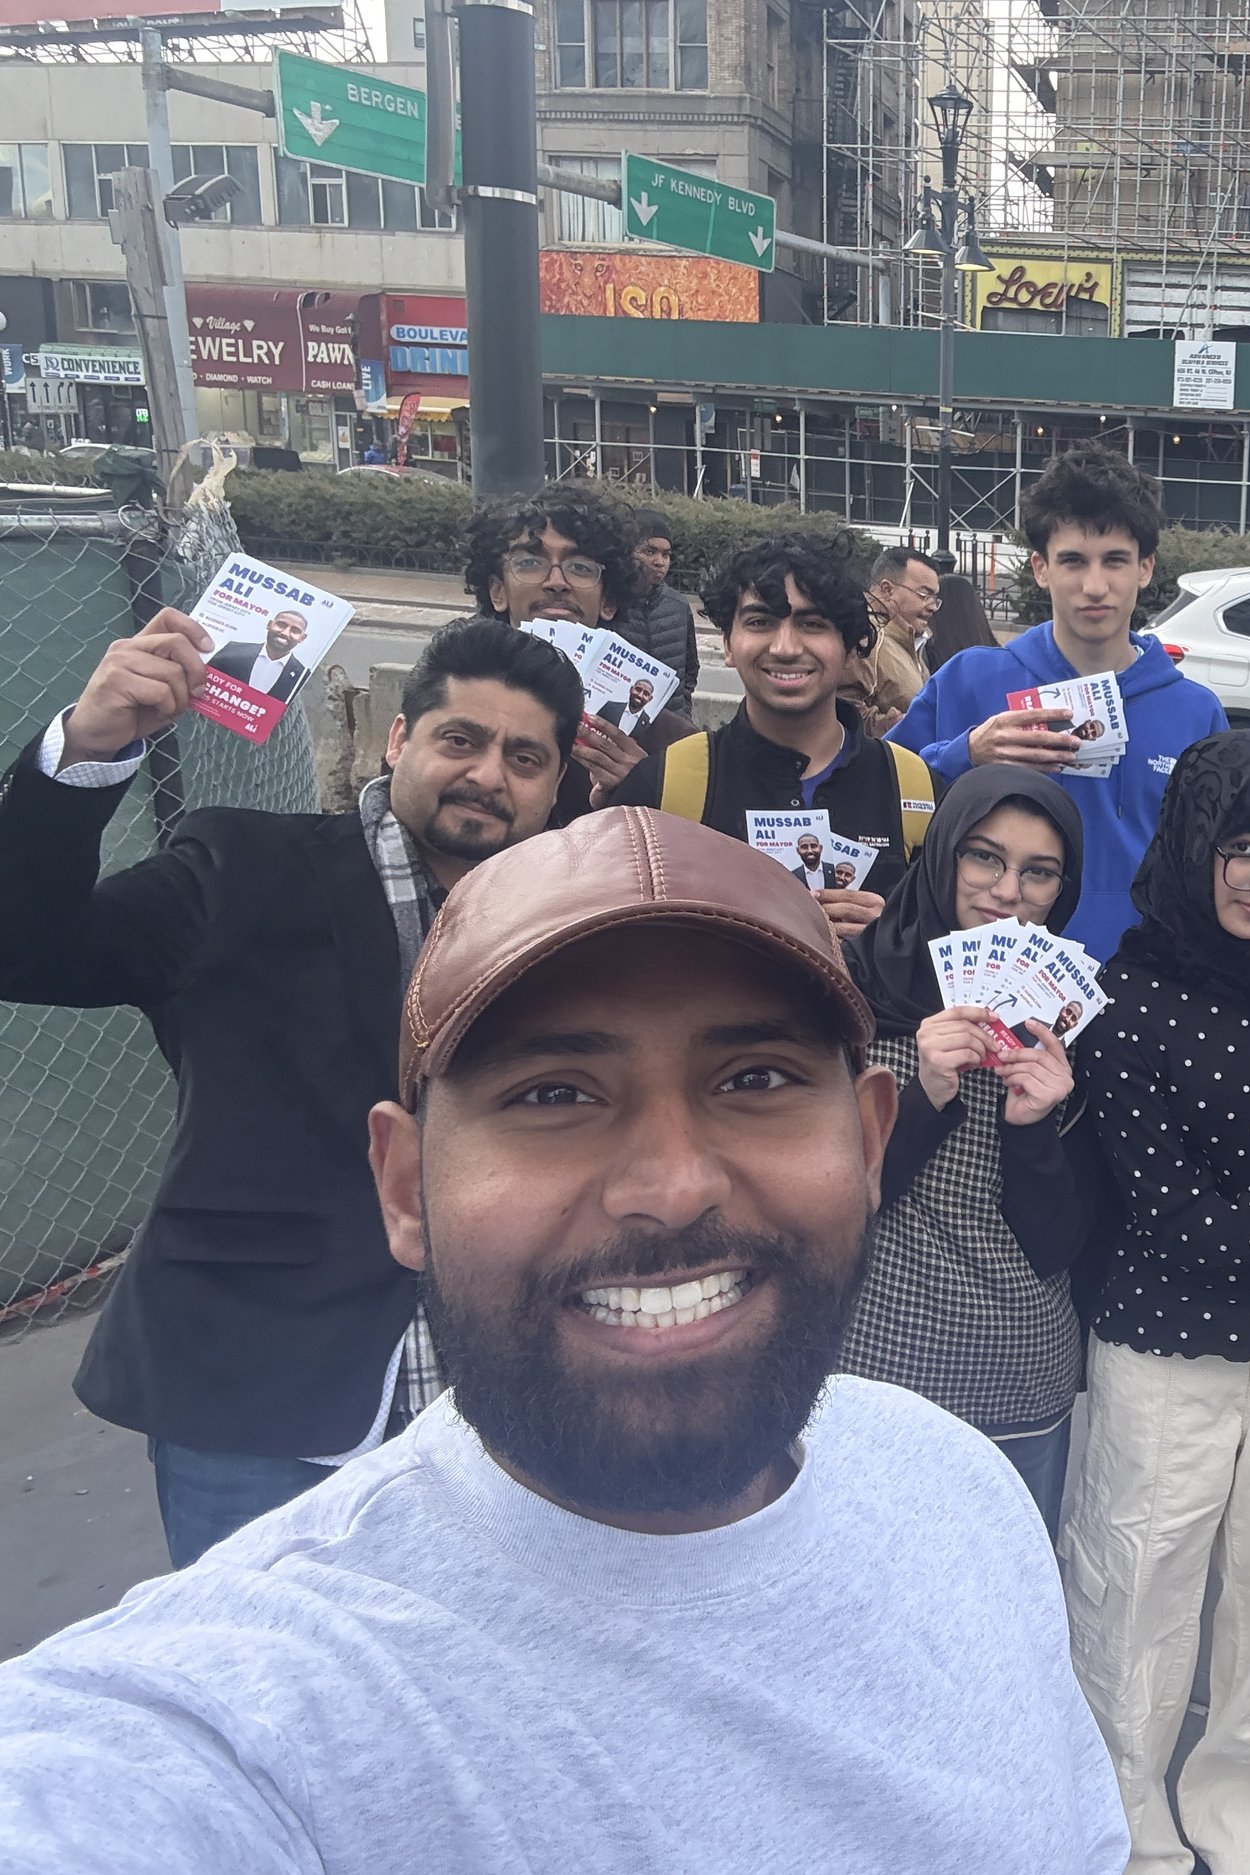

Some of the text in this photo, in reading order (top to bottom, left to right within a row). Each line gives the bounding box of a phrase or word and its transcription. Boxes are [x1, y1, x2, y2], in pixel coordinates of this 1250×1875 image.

[347, 83, 419, 119] BERGEN
[651, 173, 756, 216] JF KENNEDY BLVD
[206, 316, 242, 334] Village
[4, 348, 13, 376] WORK
[61, 358, 141, 374] CONVENIENCE
[206, 374, 238, 383] DIAMOND
[246, 376, 272, 384] WATCH
[311, 380, 332, 388] CASH
[362, 365, 371, 390] LIVE
[218, 577, 254, 598] ALI
[228, 562, 316, 607] MUSSAB
[213, 590, 269, 616] FOR MAYOR
[602, 654, 624, 669] ALI
[608, 642, 660, 677] MUSSAB
[599, 662, 632, 683] FOR MAYOR
[225, 682, 243, 694] FOR
[1090, 682, 1102, 700] ALI
[1101, 679, 1119, 730] MUSSAB
[754, 817, 812, 827] MUSSAB
[756, 830, 776, 840] ALI
[1015, 957, 1030, 969] FOR
[1044, 962, 1066, 984] ALI
[1038, 969, 1067, 1002] FOR MAYOR
[1056, 950, 1096, 1001] MUSSAB
